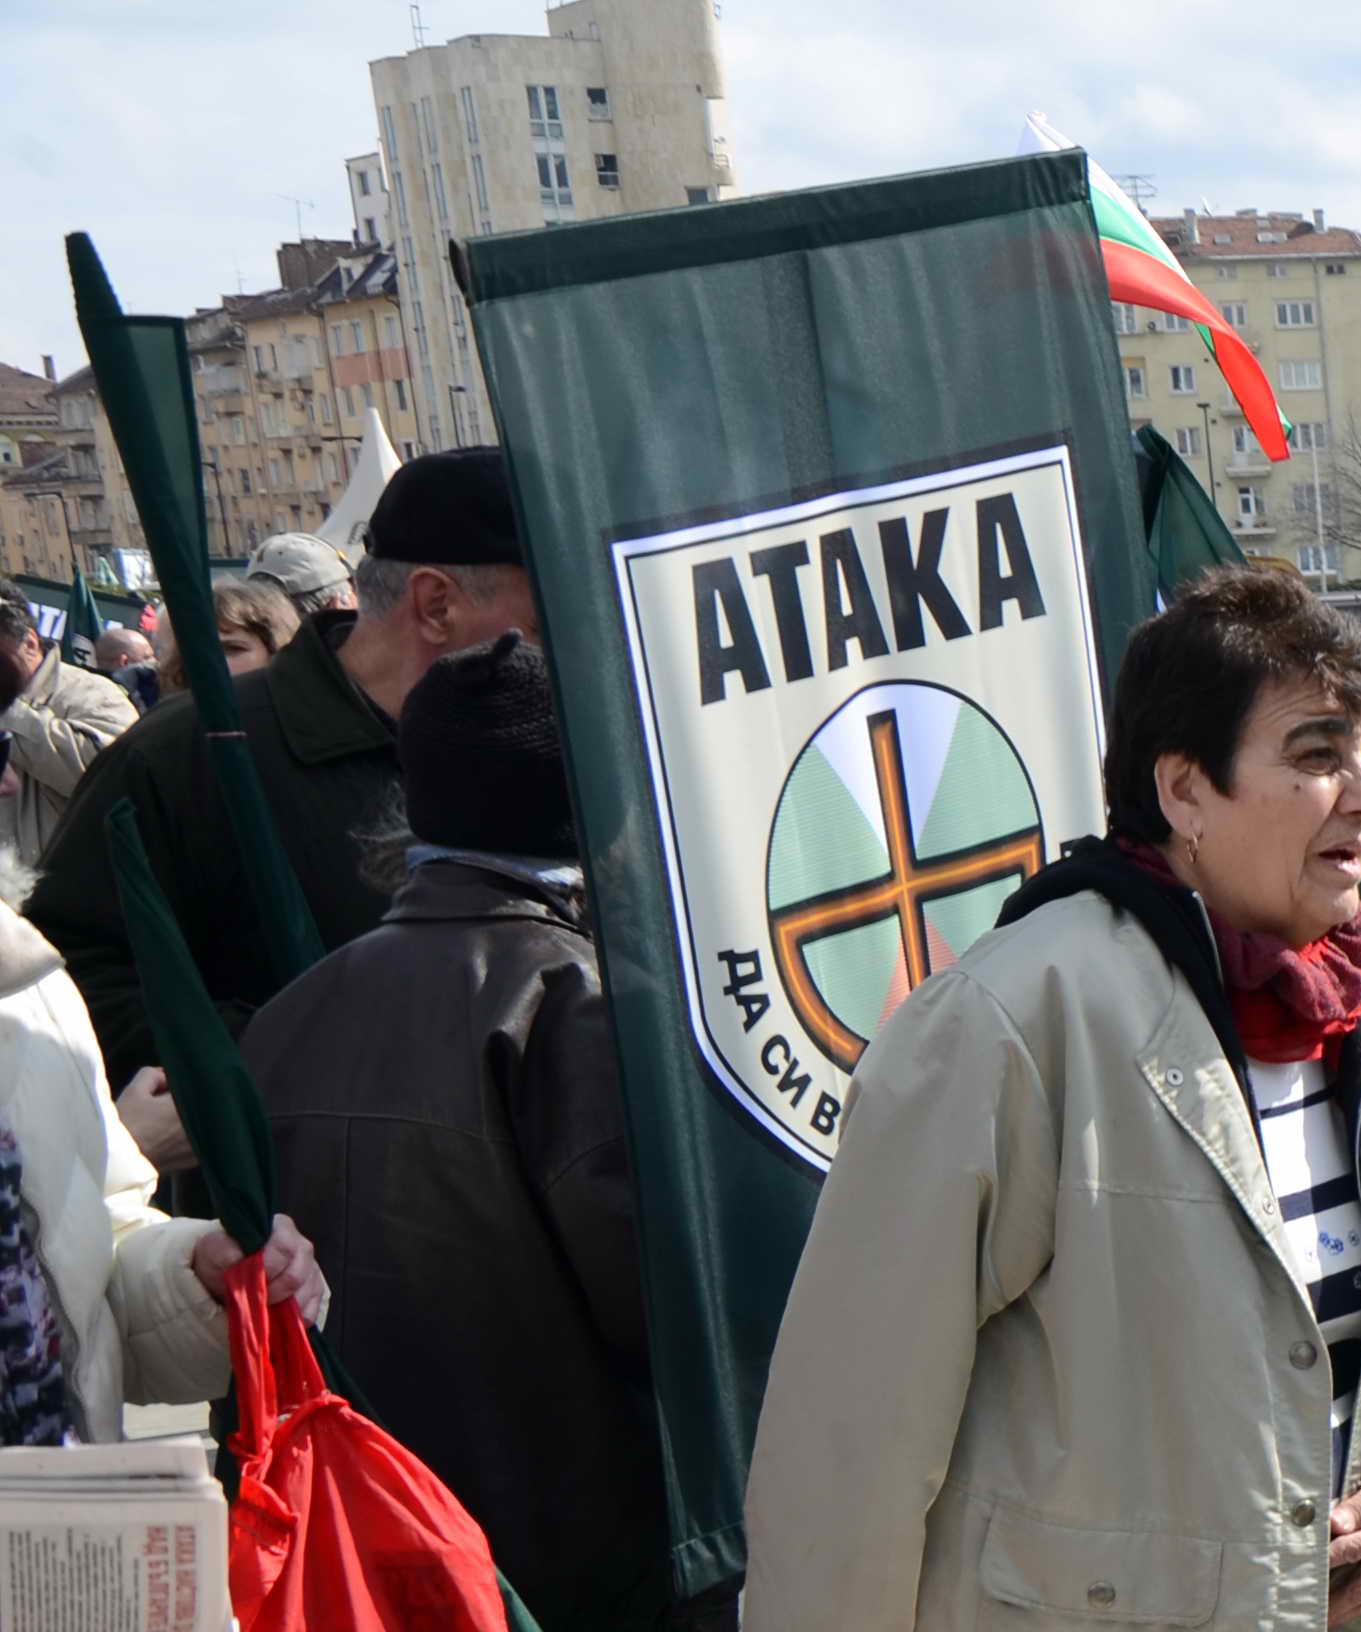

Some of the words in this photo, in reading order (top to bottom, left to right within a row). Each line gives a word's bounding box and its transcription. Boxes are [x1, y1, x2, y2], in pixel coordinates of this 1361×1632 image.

[691, 492, 1046, 706] АТАКА
[718, 948, 770, 1031] ДА
[759, 1034, 812, 1110] СИ
